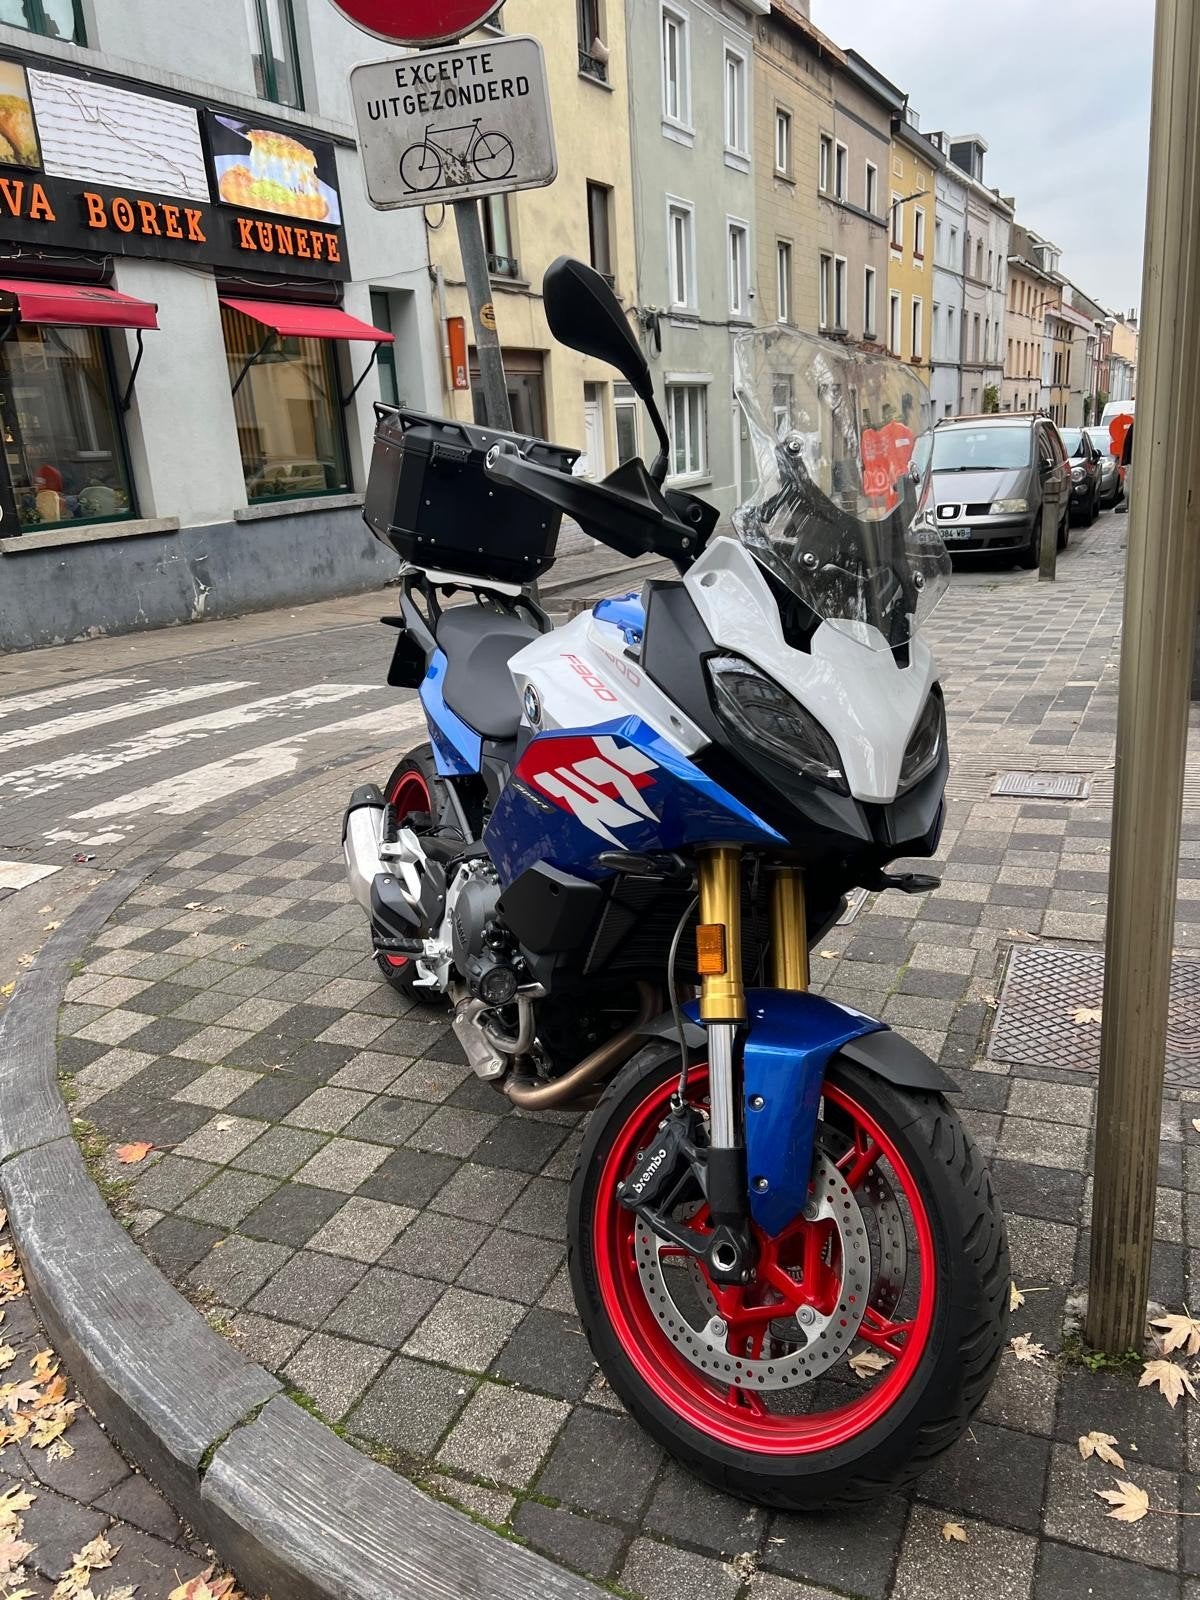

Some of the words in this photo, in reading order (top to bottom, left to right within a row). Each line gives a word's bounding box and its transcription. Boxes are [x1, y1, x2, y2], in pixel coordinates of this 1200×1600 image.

[395, 53, 494, 88] EXCEPTE
[367, 76, 530, 121] UITGEZONDERD
[0, 178, 56, 221] VA
[560, 653, 618, 702] F900
[632, 1149, 667, 1194] brembo
